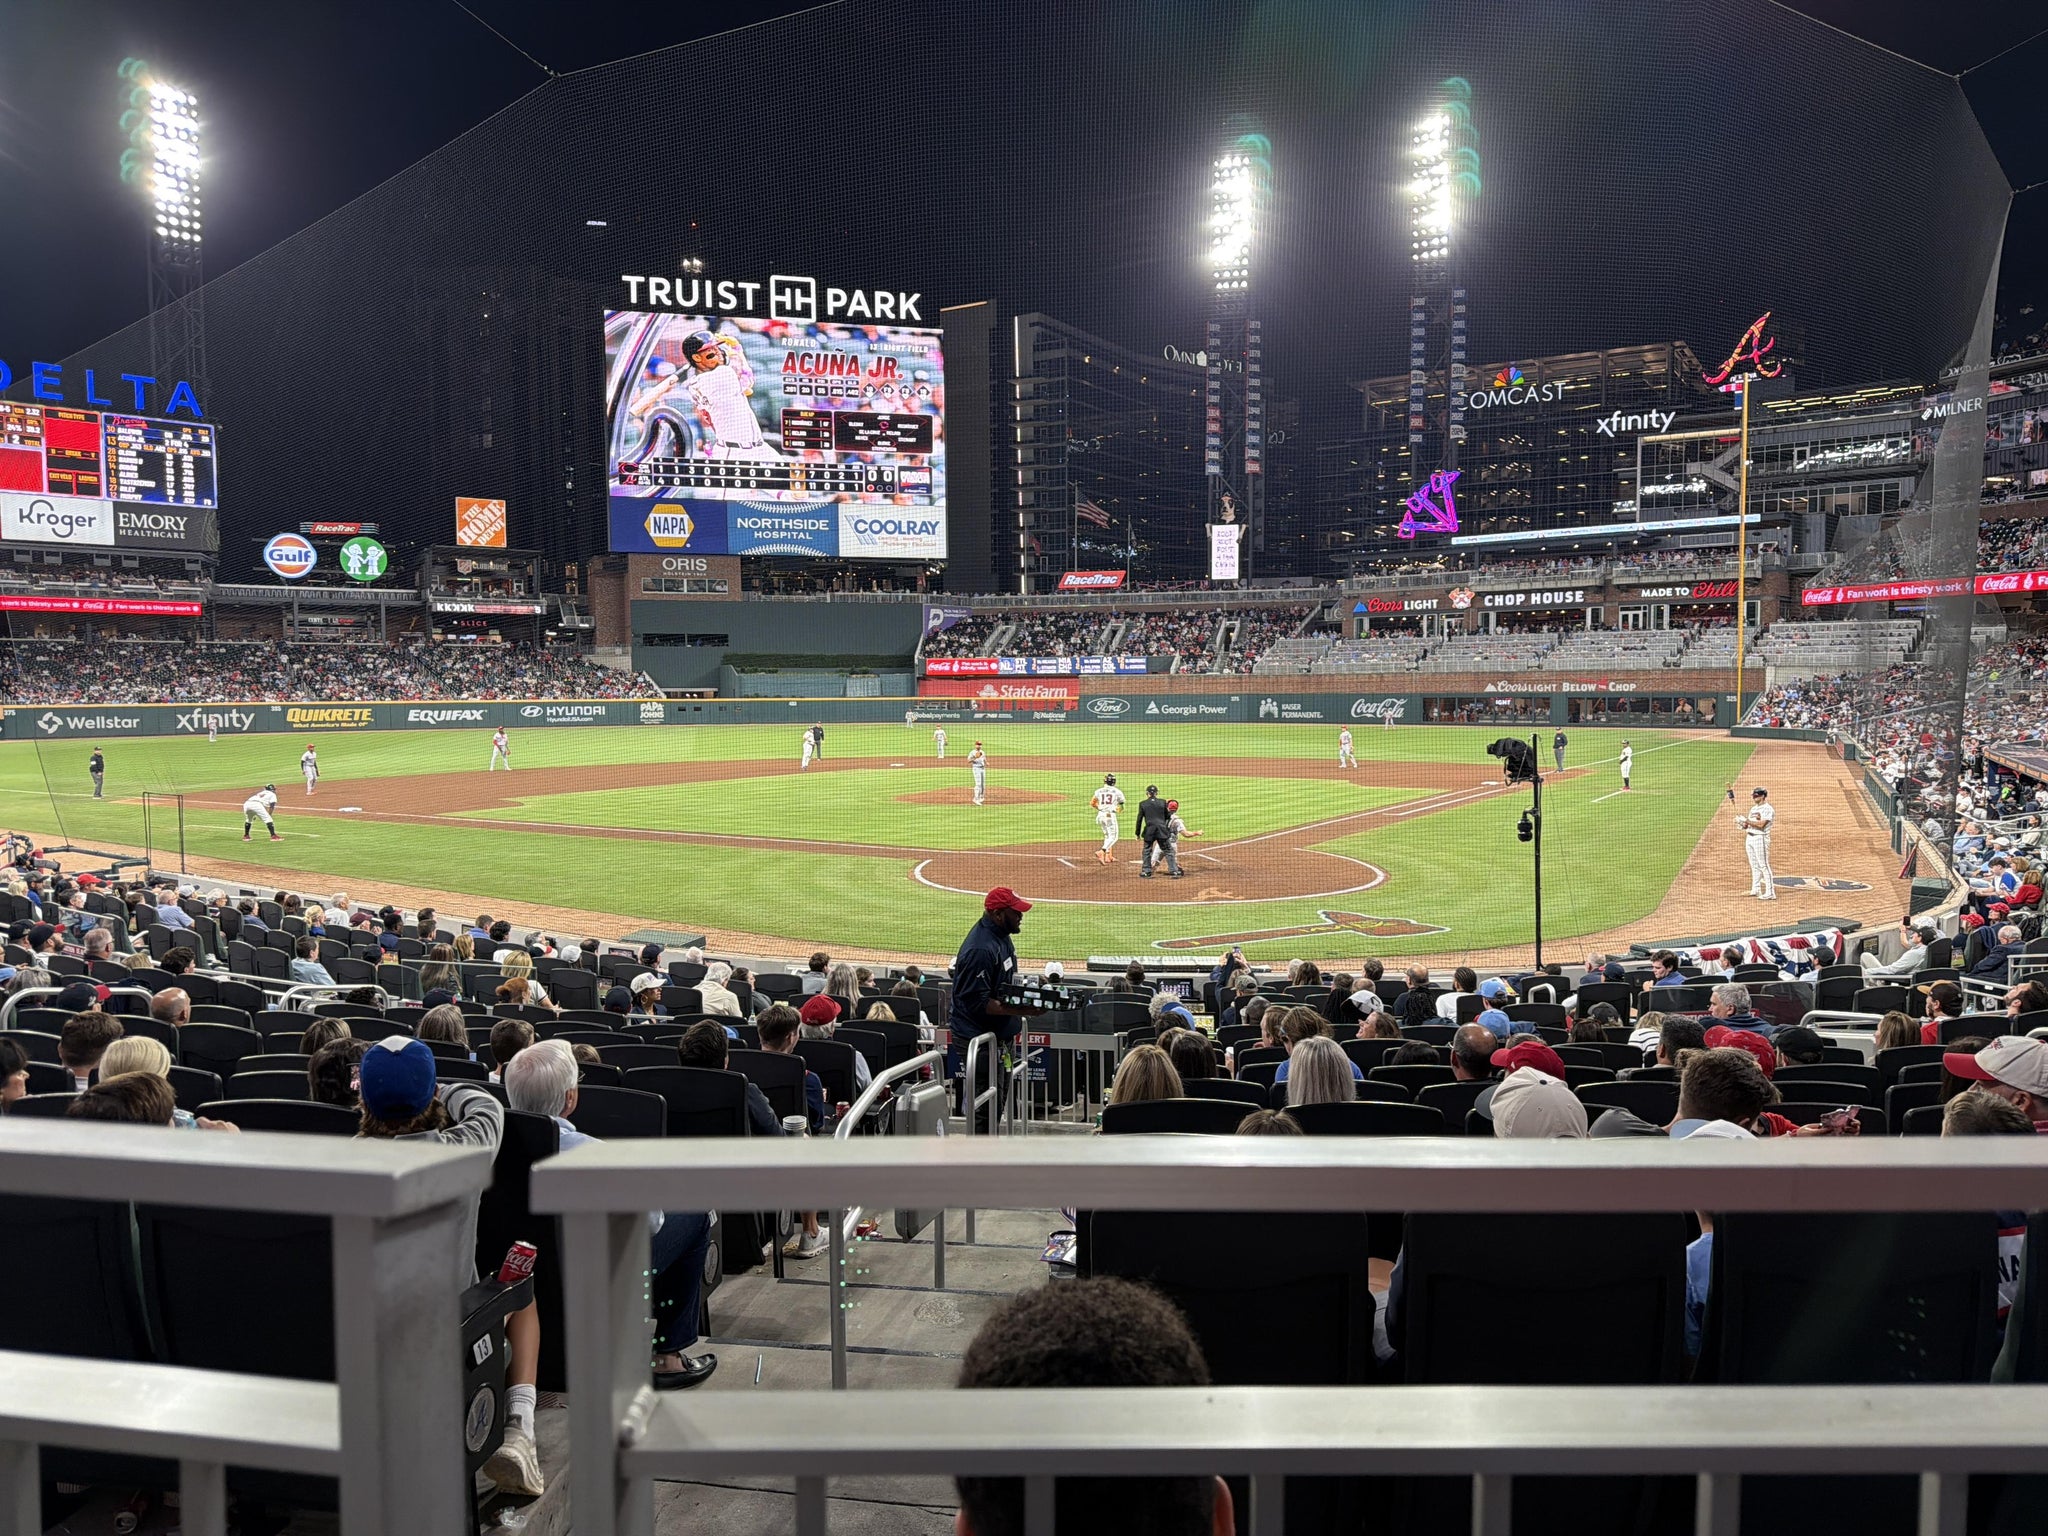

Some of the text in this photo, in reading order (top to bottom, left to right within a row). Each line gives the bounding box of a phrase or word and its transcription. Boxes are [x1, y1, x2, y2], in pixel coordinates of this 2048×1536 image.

[621, 274, 922, 321] TRUIST PARK
[781, 337, 817, 348] RONALD
[781, 348, 904, 379] ACUÑA JR.
[1452, 366, 1464, 374] 2012
[1933, 397, 1983, 419] MILNER
[1452, 412, 1464, 420] 2022
[1596, 408, 1676, 437] xfinity
[12, 434, 20, 444] 2
[107, 436, 116, 446] 13
[171, 440, 182, 448] FOR
[689, 466, 695, 474] 3
[704, 467, 710, 475] 0
[735, 468, 741, 476] 2
[750, 468, 756, 477] 0
[764, 469, 771, 477] 0
[824, 471, 830, 479] 0
[868, 471, 892, 482] 0 0
[658, 477, 664, 485] 4
[674, 477, 680, 485] 0
[704, 478, 711, 486] 0
[735, 479, 741, 487] 0
[750, 479, 756, 487] 0
[810, 482, 816, 490] 11
[19, 499, 97, 538] Kroger
[461, 503, 483, 521] THE
[117, 511, 188, 531] EMORY
[458, 500, 504, 545] HOME
[652, 515, 687, 536] NAPA
[736, 517, 829, 531] NORTHSIDE
[853, 518, 940, 535] COOLRAY
[119, 529, 187, 539] HEALTHCARE
[314, 523, 356, 534] RaceTrac
[477, 518, 505, 546] DEPOT
[754, 530, 813, 540] HOSPITAL
[268, 549, 311, 563] Gulf
[662, 557, 707, 571] ORIS
[1063, 574, 1118, 587] RaceTrac
[1982, 575, 2020, 590] Coca-Cola
[1641, 580, 1739, 599] MADE TO Chill
[1804, 582, 1962, 603] Coca-Cola Fan work is thirsty work
[153, 604, 174, 612] thirsty
[1367, 590, 1584, 613] Coors LIGHT CHOP HOUSE
[999, 661, 1013, 671] NL
[1000, 684, 1067, 698] State Farm
[1497, 680, 1528, 692] Coors
[1528, 683, 1557, 692] LIGHT
[1562, 682, 1596, 692] BELOW
[1608, 682, 1637, 692] CHOP
[546, 705, 606, 716] HYUNDAI
[1094, 700, 1122, 712] Ford
[1161, 704, 1228, 716] Georgia Power
[176, 707, 255, 732] xfinity
[286, 708, 372, 723] QUIKRETE
[408, 709, 485, 724] EQUIFAX
[640, 711, 664, 719] JOHNS
[1040, 711, 1066, 719] National
[66, 716, 140, 730] Wellstar
[1101, 793, 1113, 805] 13
[477, 1338, 489, 1363] 13
